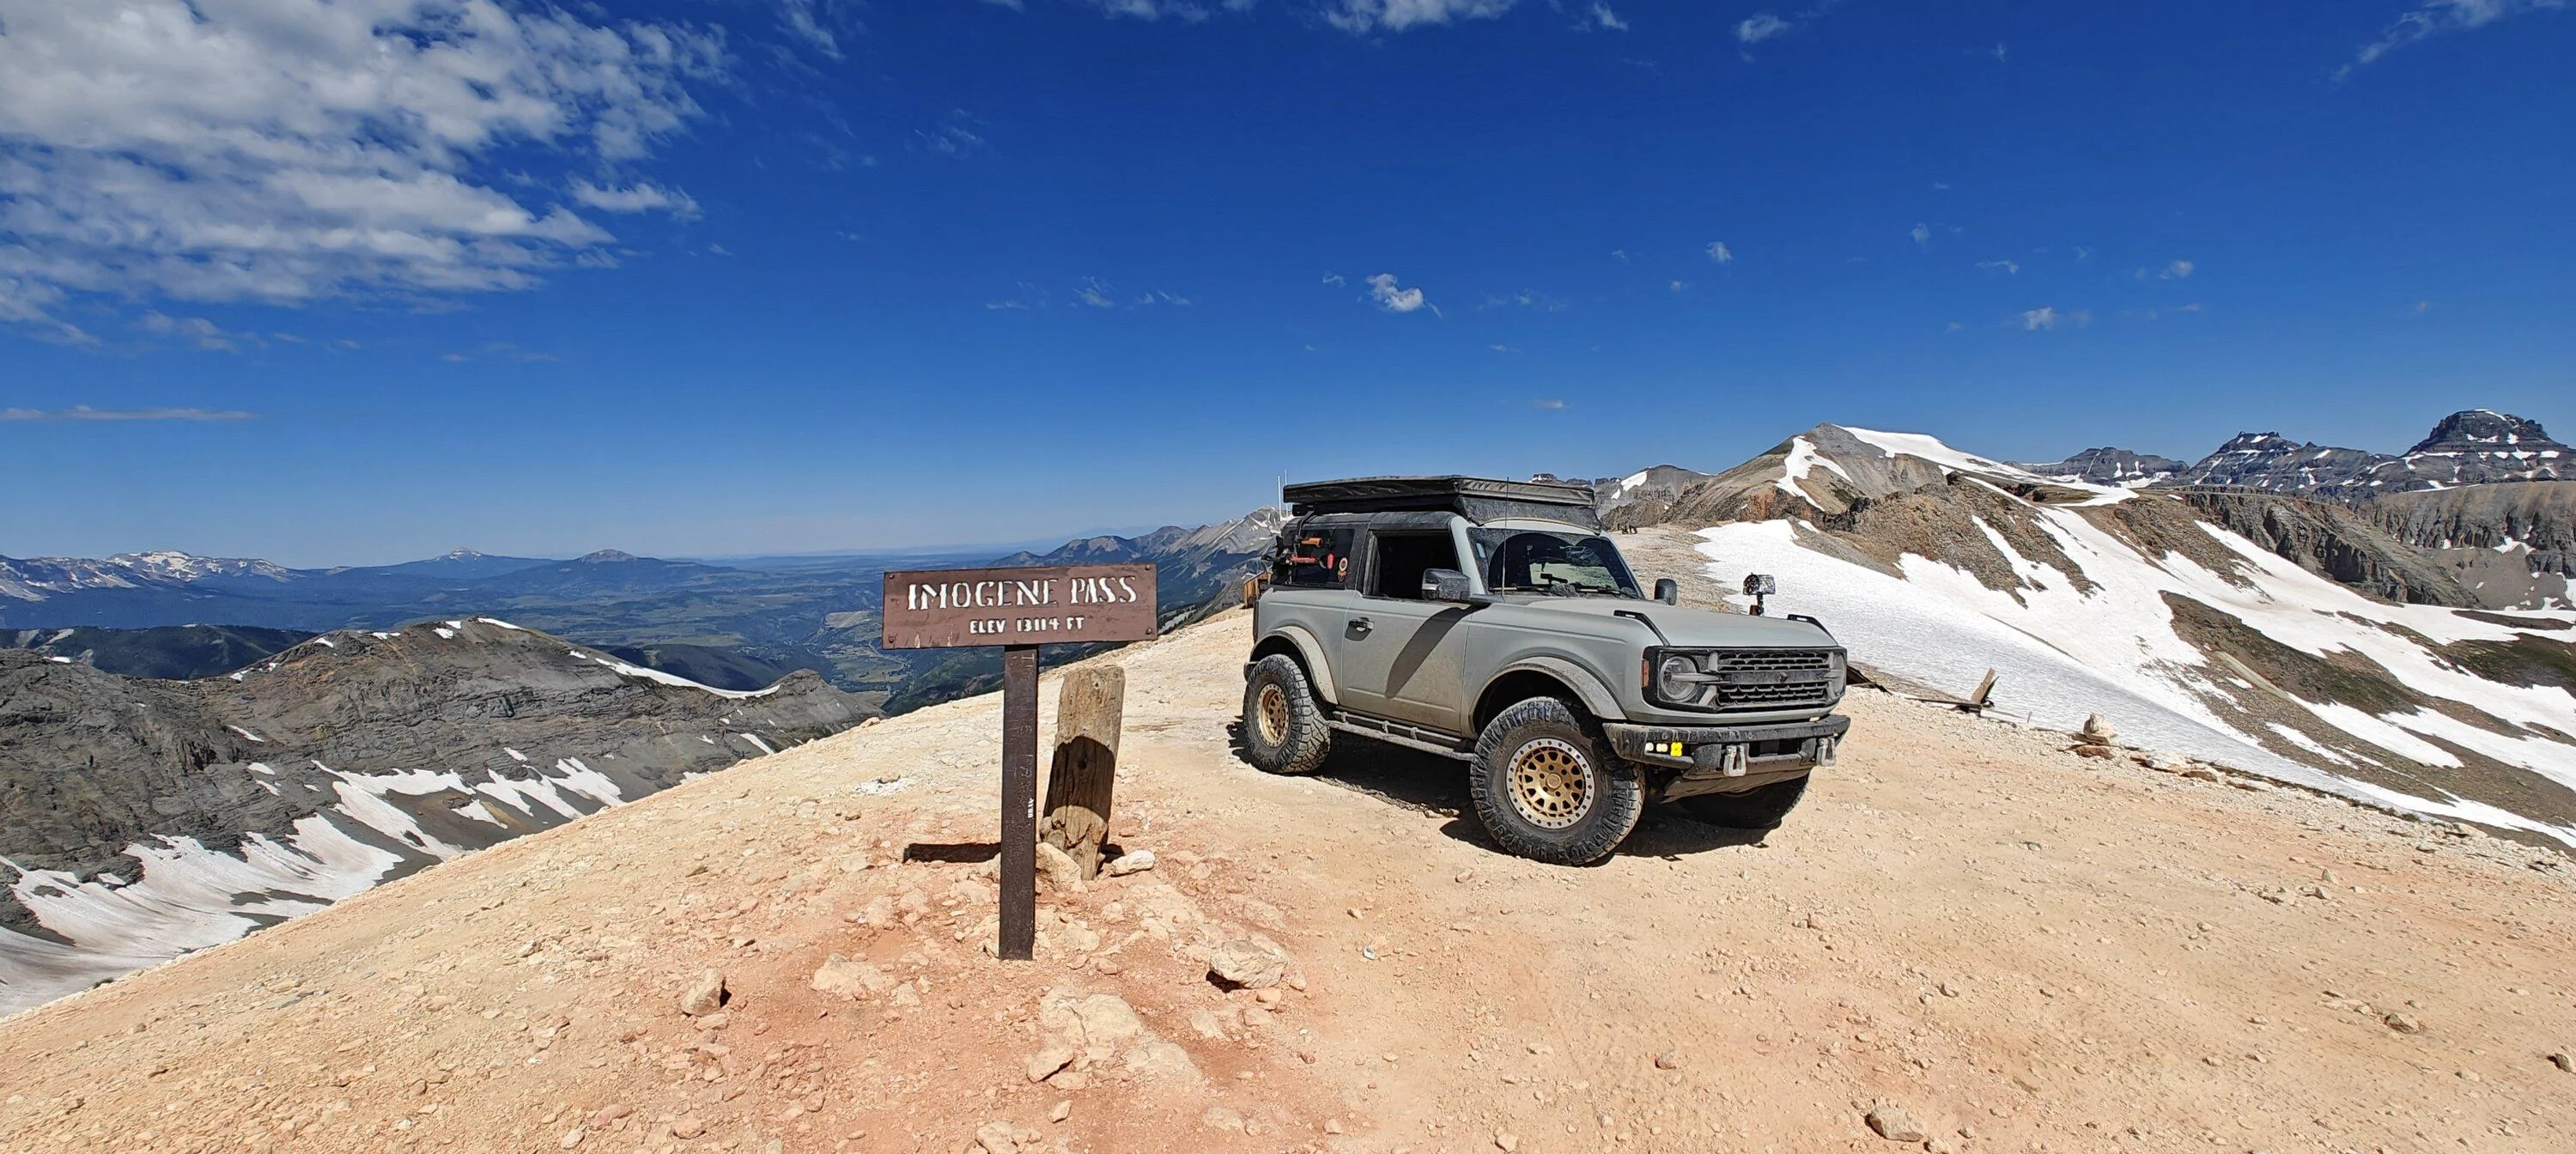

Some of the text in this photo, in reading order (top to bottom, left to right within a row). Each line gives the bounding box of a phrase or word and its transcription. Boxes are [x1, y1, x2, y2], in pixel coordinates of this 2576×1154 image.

[908, 575, 1137, 610] IMOGENE PASS
[969, 616, 1085, 634] ELEV 13114 FT
